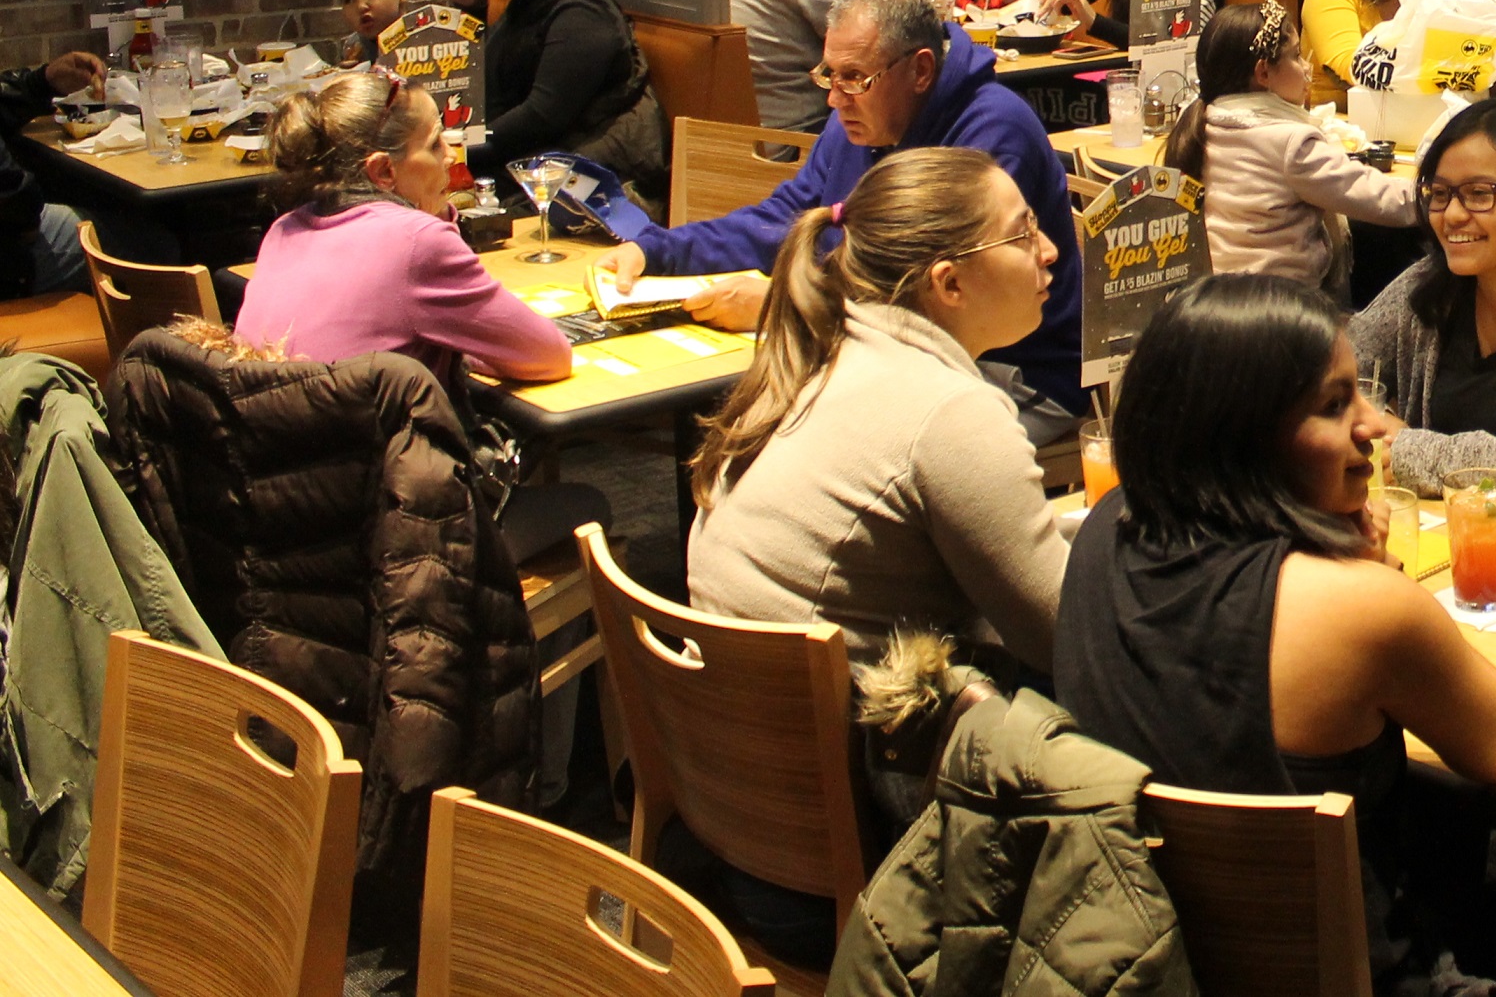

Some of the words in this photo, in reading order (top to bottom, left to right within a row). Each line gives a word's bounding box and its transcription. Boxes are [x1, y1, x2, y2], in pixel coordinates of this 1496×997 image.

[395, 44, 430, 63] YOU
[432, 40, 470, 61] GIVE
[395, 60, 436, 78] You
[436, 53, 468, 80] Get
[1103, 222, 1144, 252] YOU
[1148, 211, 1190, 243] GIVE
[1103, 246, 1151, 280] You
[1152, 230, 1188, 270] Get
[1104, 281, 1119, 295] GET
[1119, 279, 1126, 292] A
[1136, 270, 1164, 288] BLAZIN'
[1165, 266, 1190, 281] BONUS
